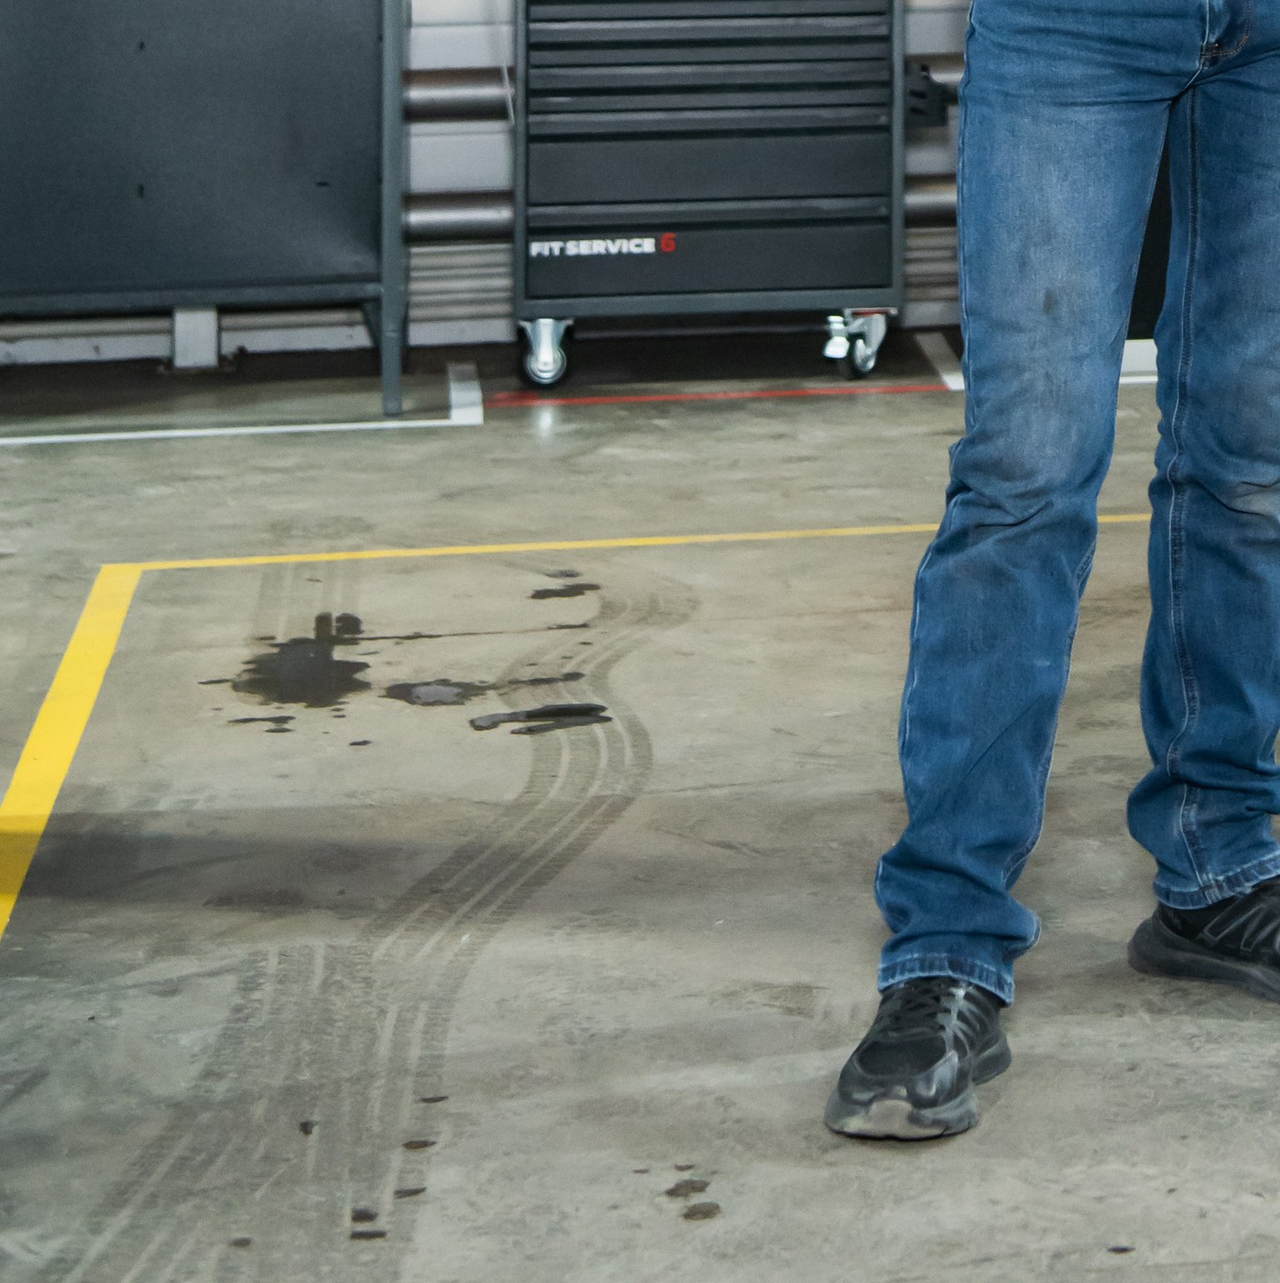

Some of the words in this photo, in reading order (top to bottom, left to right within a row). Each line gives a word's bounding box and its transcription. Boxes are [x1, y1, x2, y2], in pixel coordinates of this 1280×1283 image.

[529, 241, 564, 257] FIT
[565, 238, 656, 256] SERVICE
[660, 232, 676, 253] 6
